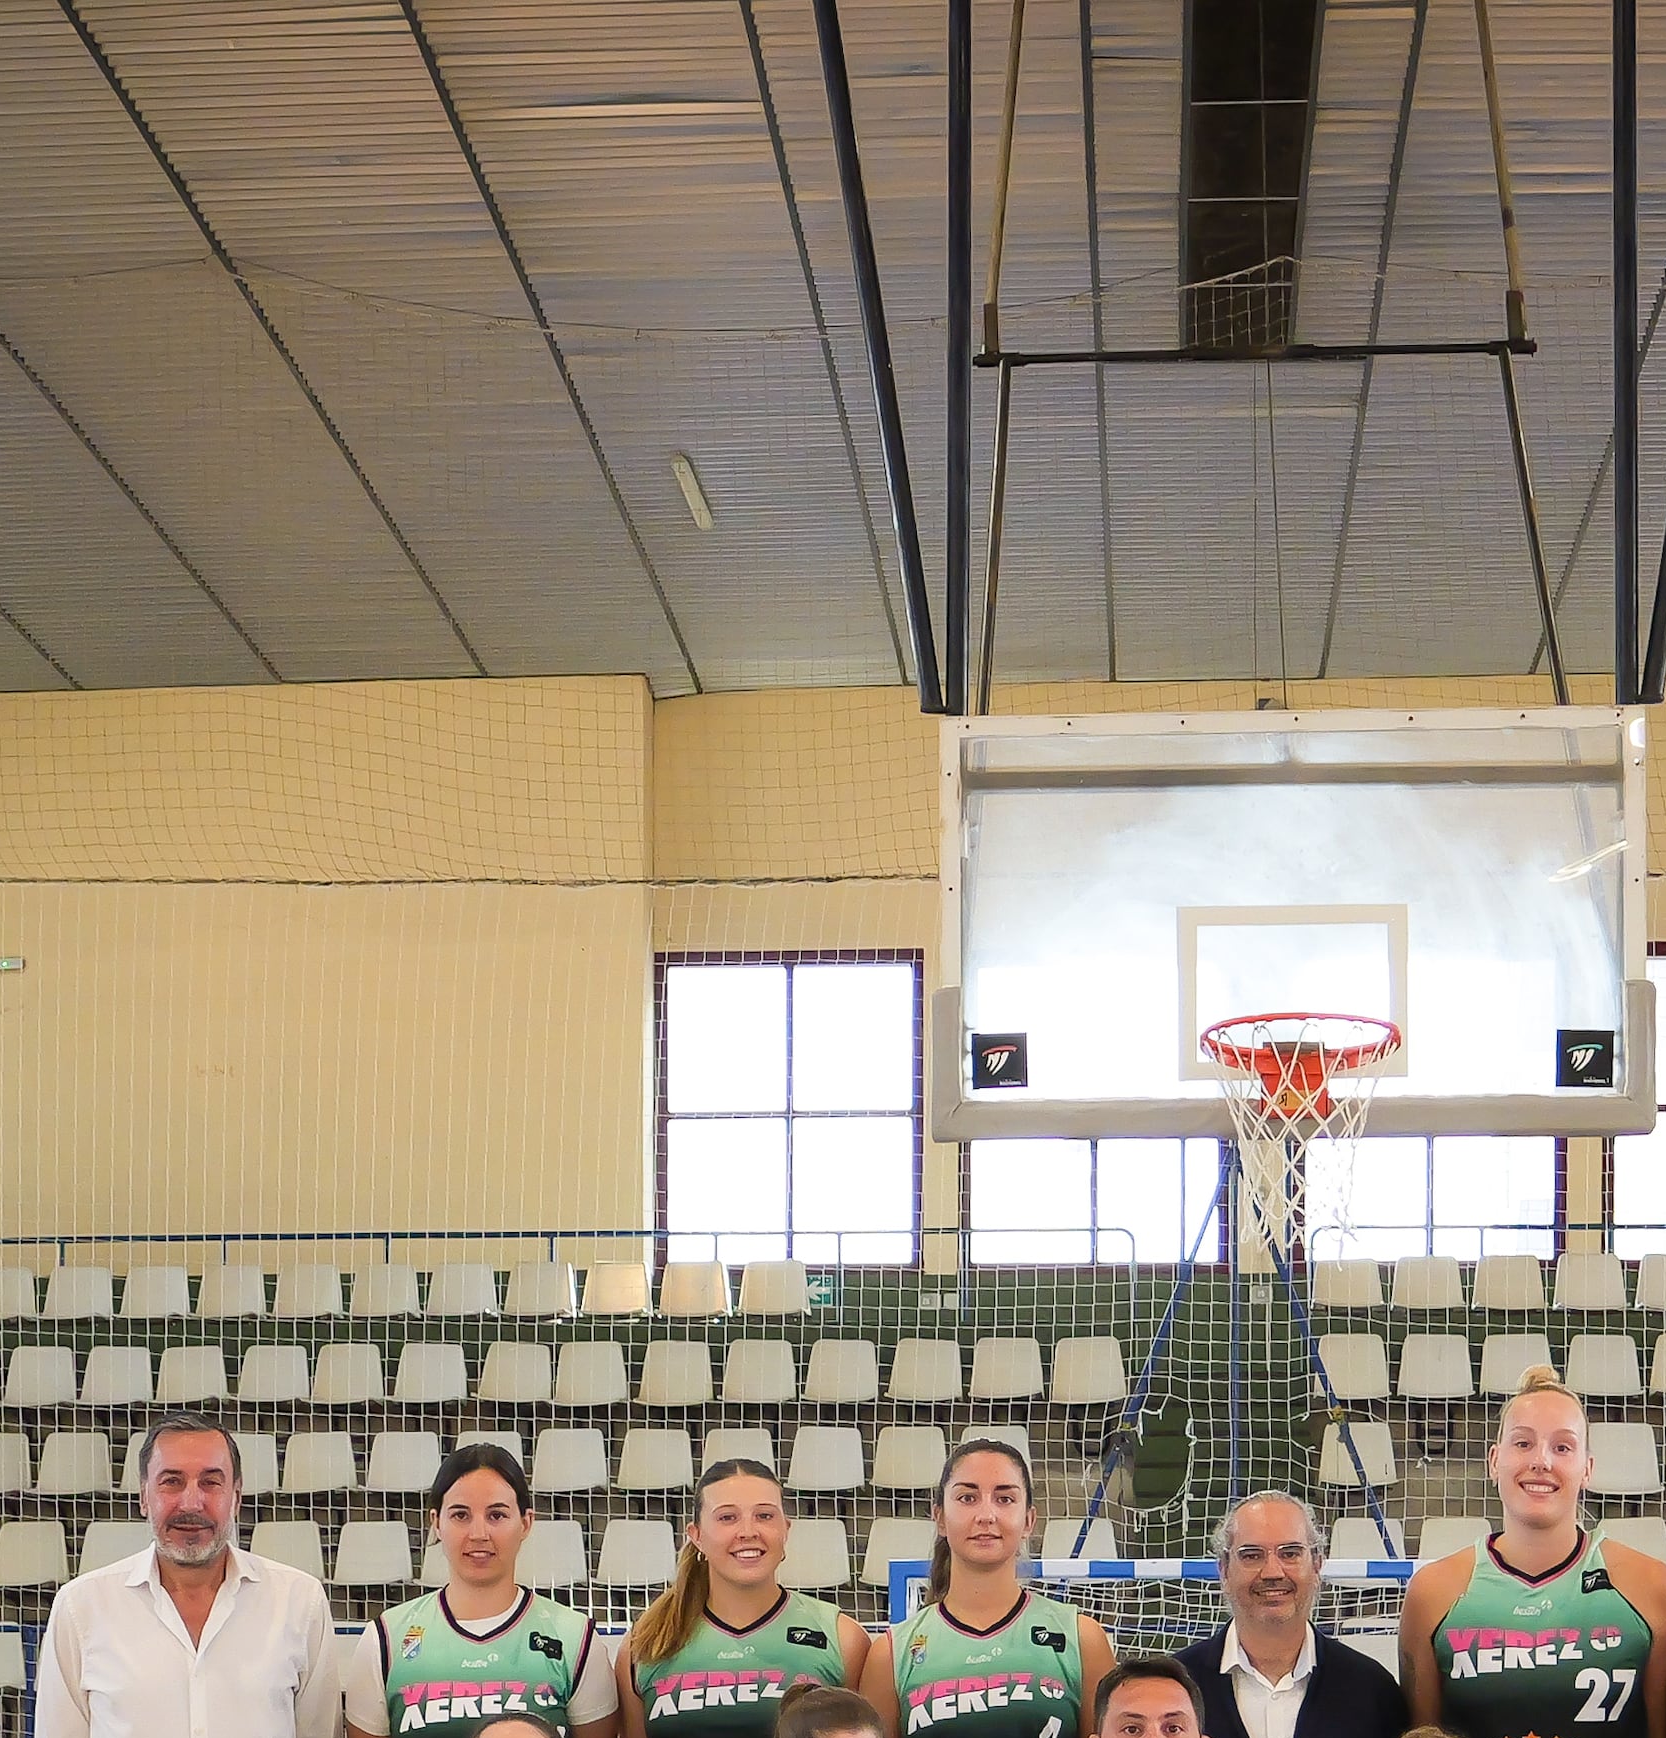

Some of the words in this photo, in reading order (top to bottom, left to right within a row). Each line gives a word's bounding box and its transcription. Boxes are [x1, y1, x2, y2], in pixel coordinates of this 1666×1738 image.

[1445, 1627, 1583, 1680] XEREZ
[399, 1681, 527, 1733] XEREZ
[648, 1670, 785, 1721] XEREZ
[907, 1672, 1033, 1735] XEREZ
[1573, 1667, 1637, 1723] 27
